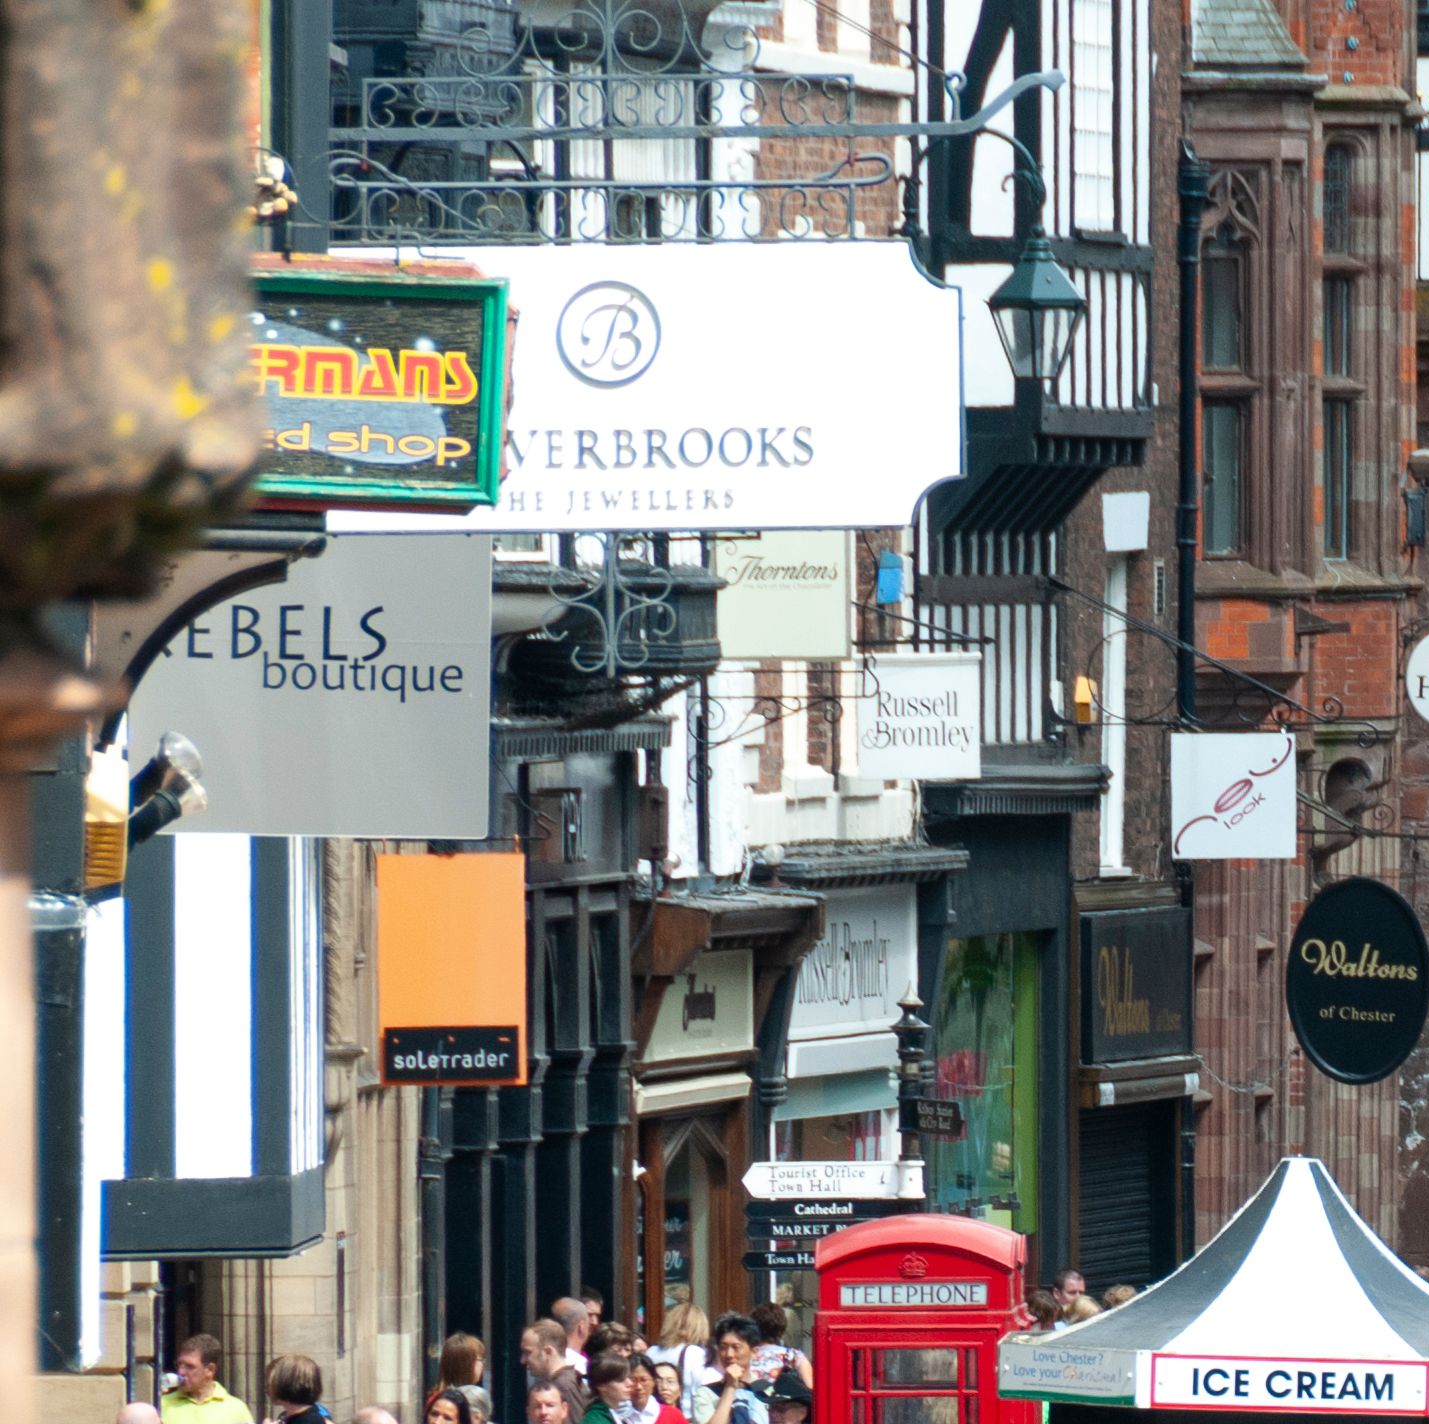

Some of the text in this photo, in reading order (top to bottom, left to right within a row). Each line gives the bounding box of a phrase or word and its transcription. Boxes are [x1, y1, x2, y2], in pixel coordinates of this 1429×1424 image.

[328, 424, 471, 466] shop
[566, 489, 735, 514] JEWELLERS
[728, 556, 838, 582] Thorntons
[187, 604, 388, 663] EBELS
[262, 651, 464, 703] boutique
[876, 690, 959, 718] Russell
[1301, 938, 1418, 981] Waltons
[1319, 1005, 1396, 1023] of Chester
[768, 1165, 866, 1179] Tourist Office
[768, 1179, 843, 1192] Town Hall
[794, 1203, 854, 1216] Cathedral
[772, 1224, 830, 1236] MARKET
[765, 1253, 794, 1266] Town
[844, 1285, 982, 1304] TELEPHONE
[1033, 1349, 1104, 1366] Love Chester?
[1013, 1363, 1036, 1376] Love
[1038, 1367, 1062, 1382] your
[1192, 1367, 1395, 1401] ICE CREAM
